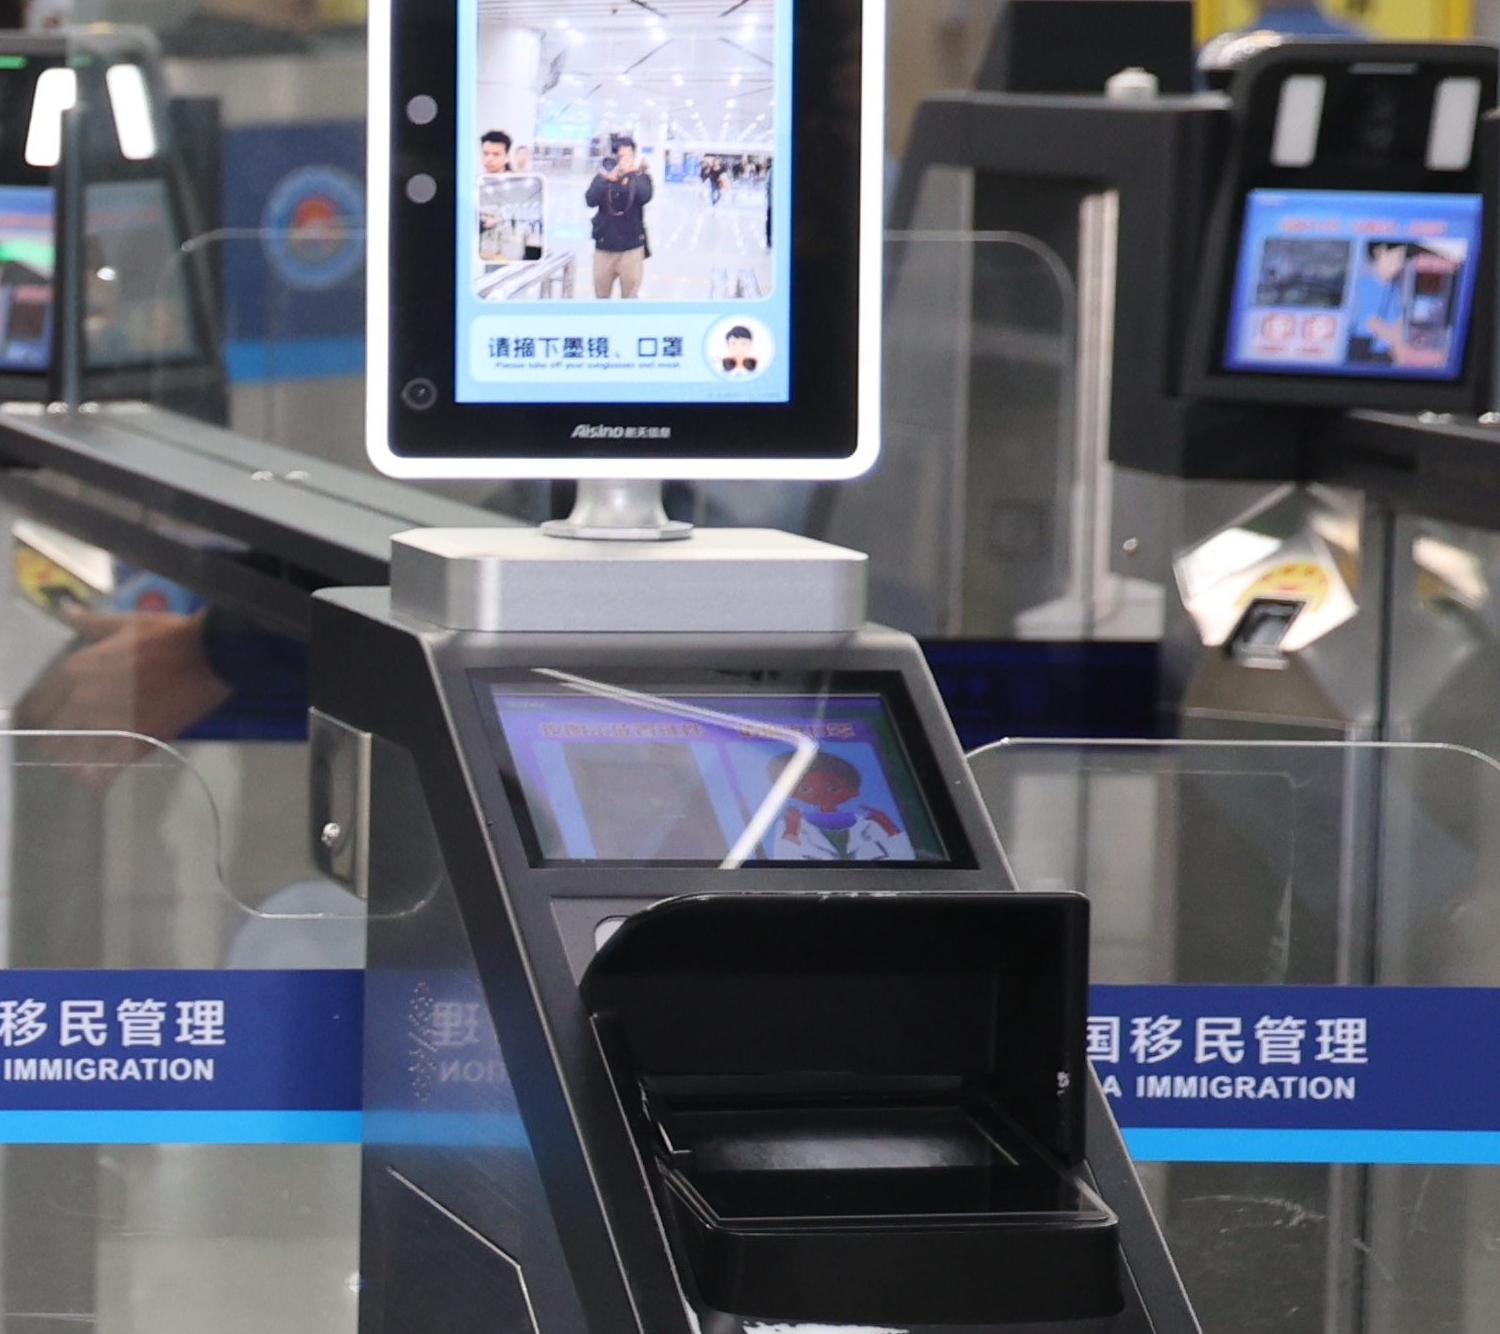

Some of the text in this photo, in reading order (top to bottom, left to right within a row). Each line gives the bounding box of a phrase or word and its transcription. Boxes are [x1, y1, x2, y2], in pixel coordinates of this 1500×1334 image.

[489, 336, 684, 359] 请摘下墨镜、口罩
[1087, 1015, 1368, 1064] 国移民管理
[4, 1058, 214, 1081] IMMIGRATION
[1136, 1075, 1356, 1099] IMMIGRATION
